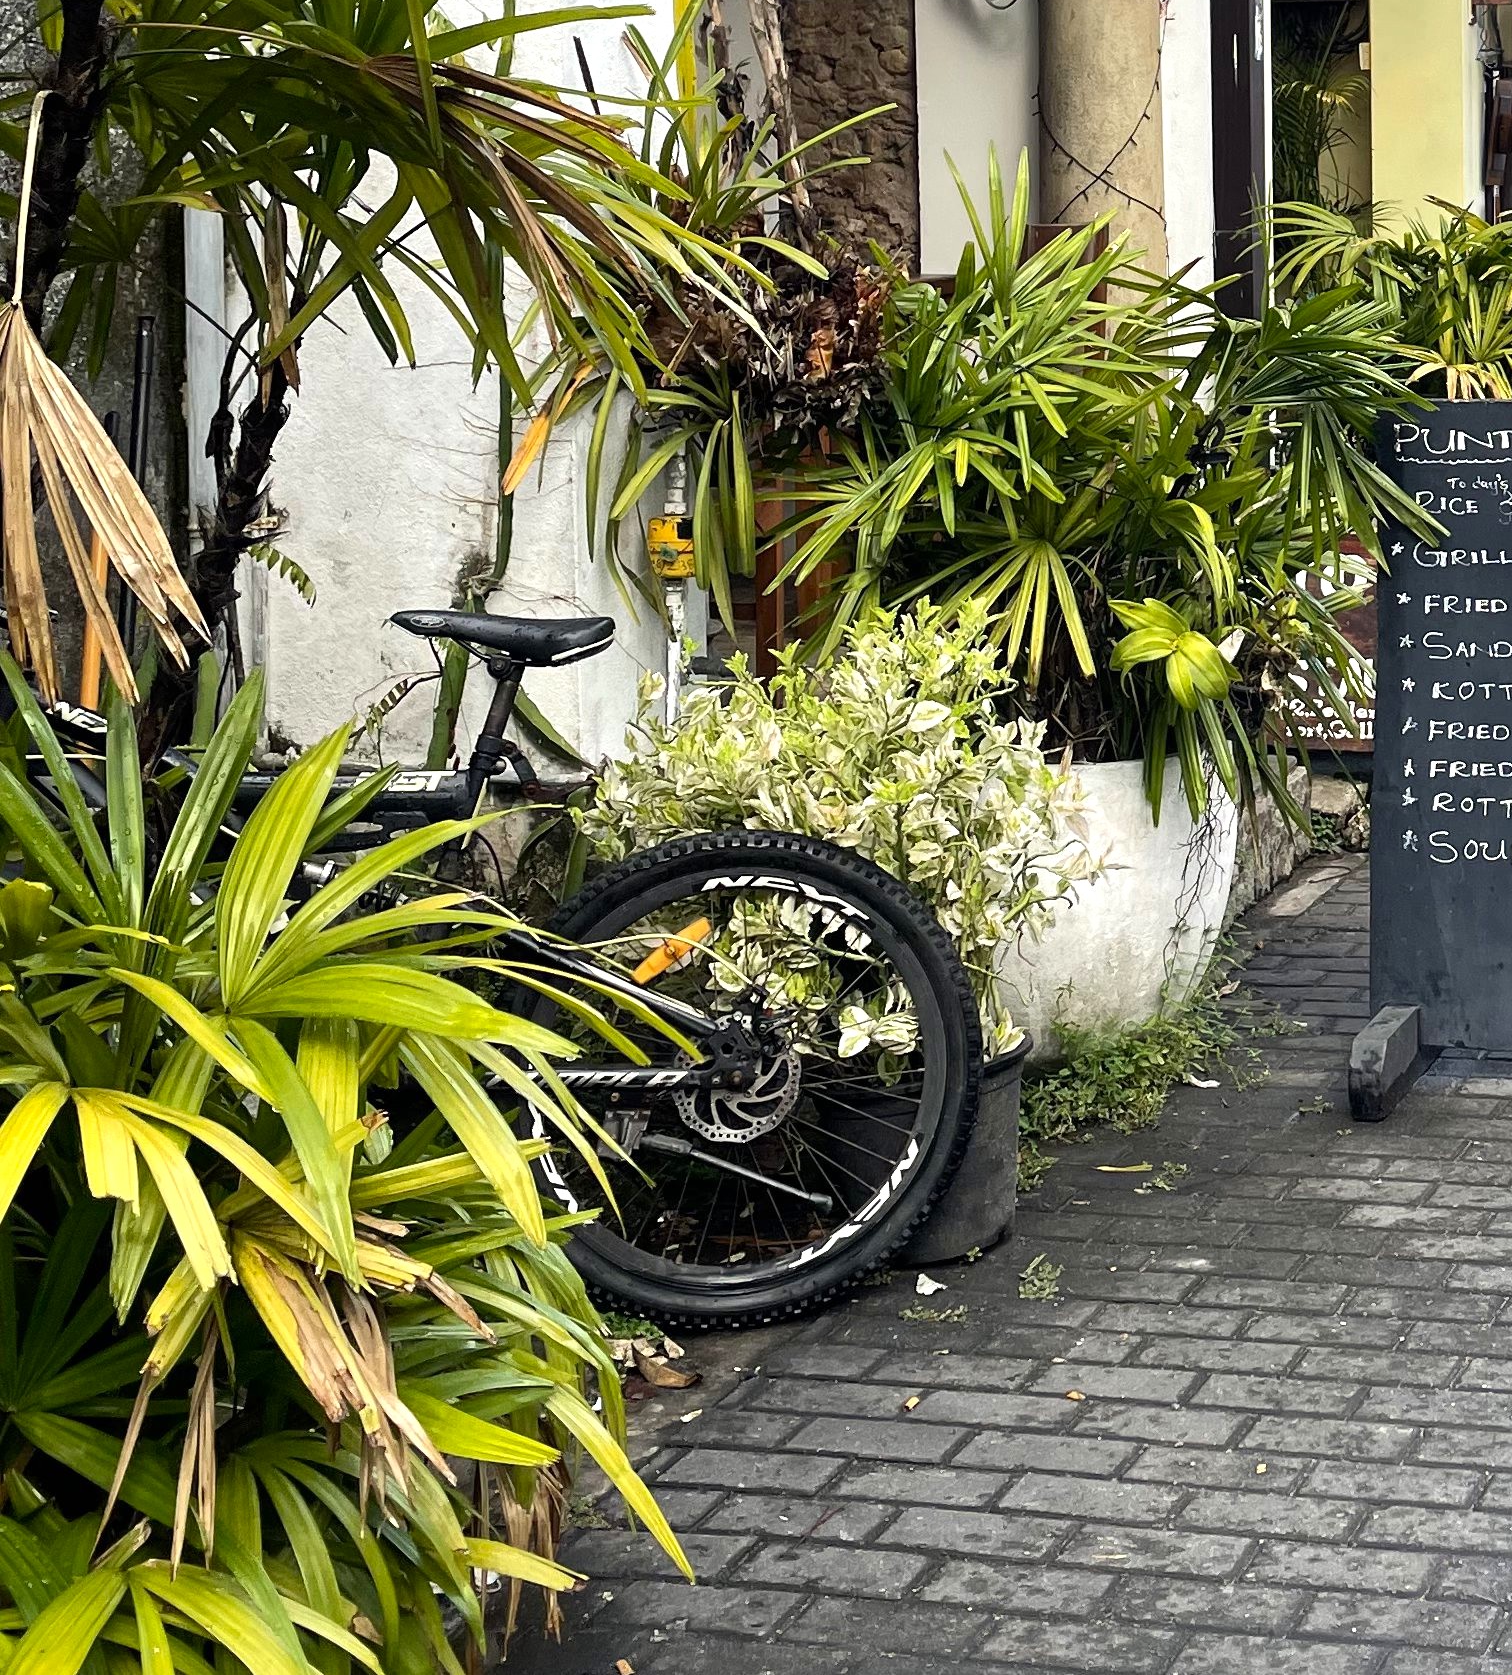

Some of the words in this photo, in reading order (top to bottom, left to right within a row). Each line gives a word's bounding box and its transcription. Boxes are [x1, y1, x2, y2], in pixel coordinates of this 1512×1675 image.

[1414, 491, 1479, 516] RICE
[1424, 594, 1508, 614] FRIED
[1428, 719, 1511, 741] FRIED
